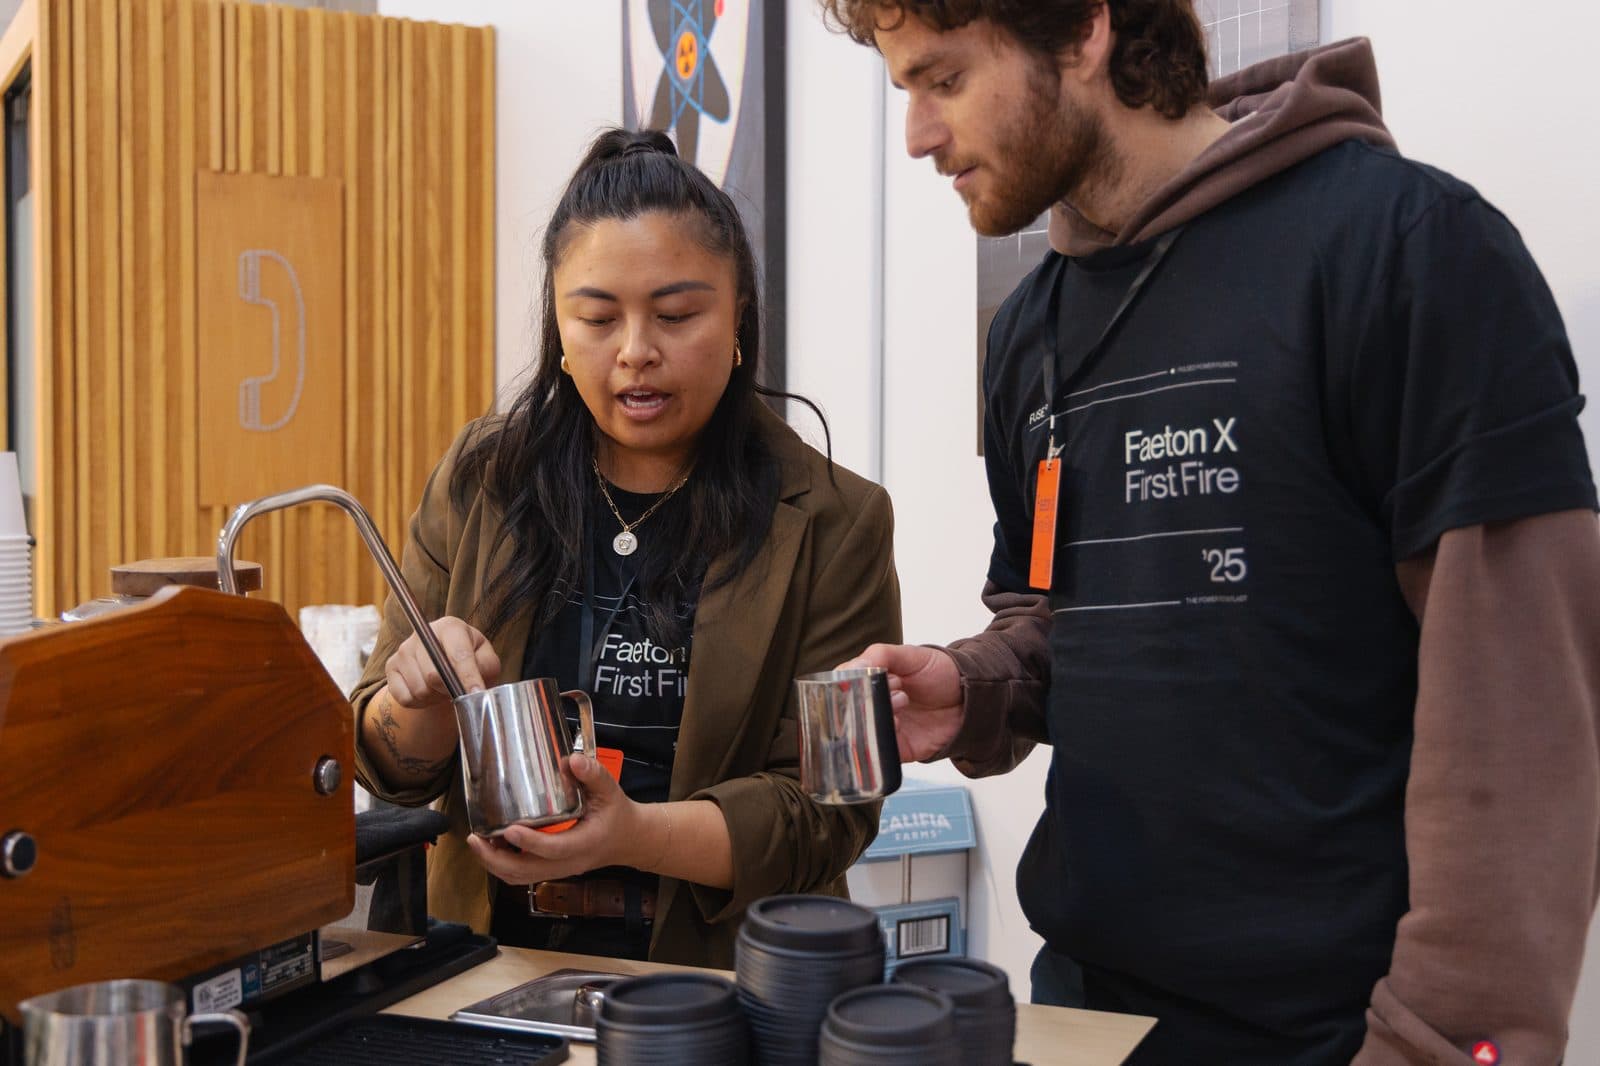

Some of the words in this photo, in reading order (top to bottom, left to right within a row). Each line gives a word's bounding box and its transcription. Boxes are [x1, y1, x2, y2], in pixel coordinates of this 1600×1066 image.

[1125, 425, 1207, 464] Faeton
[1213, 417, 1238, 453] X
[1126, 466, 1178, 503] First
[1181, 461, 1239, 494] Fire
[1202, 547, 1247, 582] '25
[594, 665, 652, 697] First
[658, 669, 688, 697] Fir
[895, 829, 938, 841] FARMS
